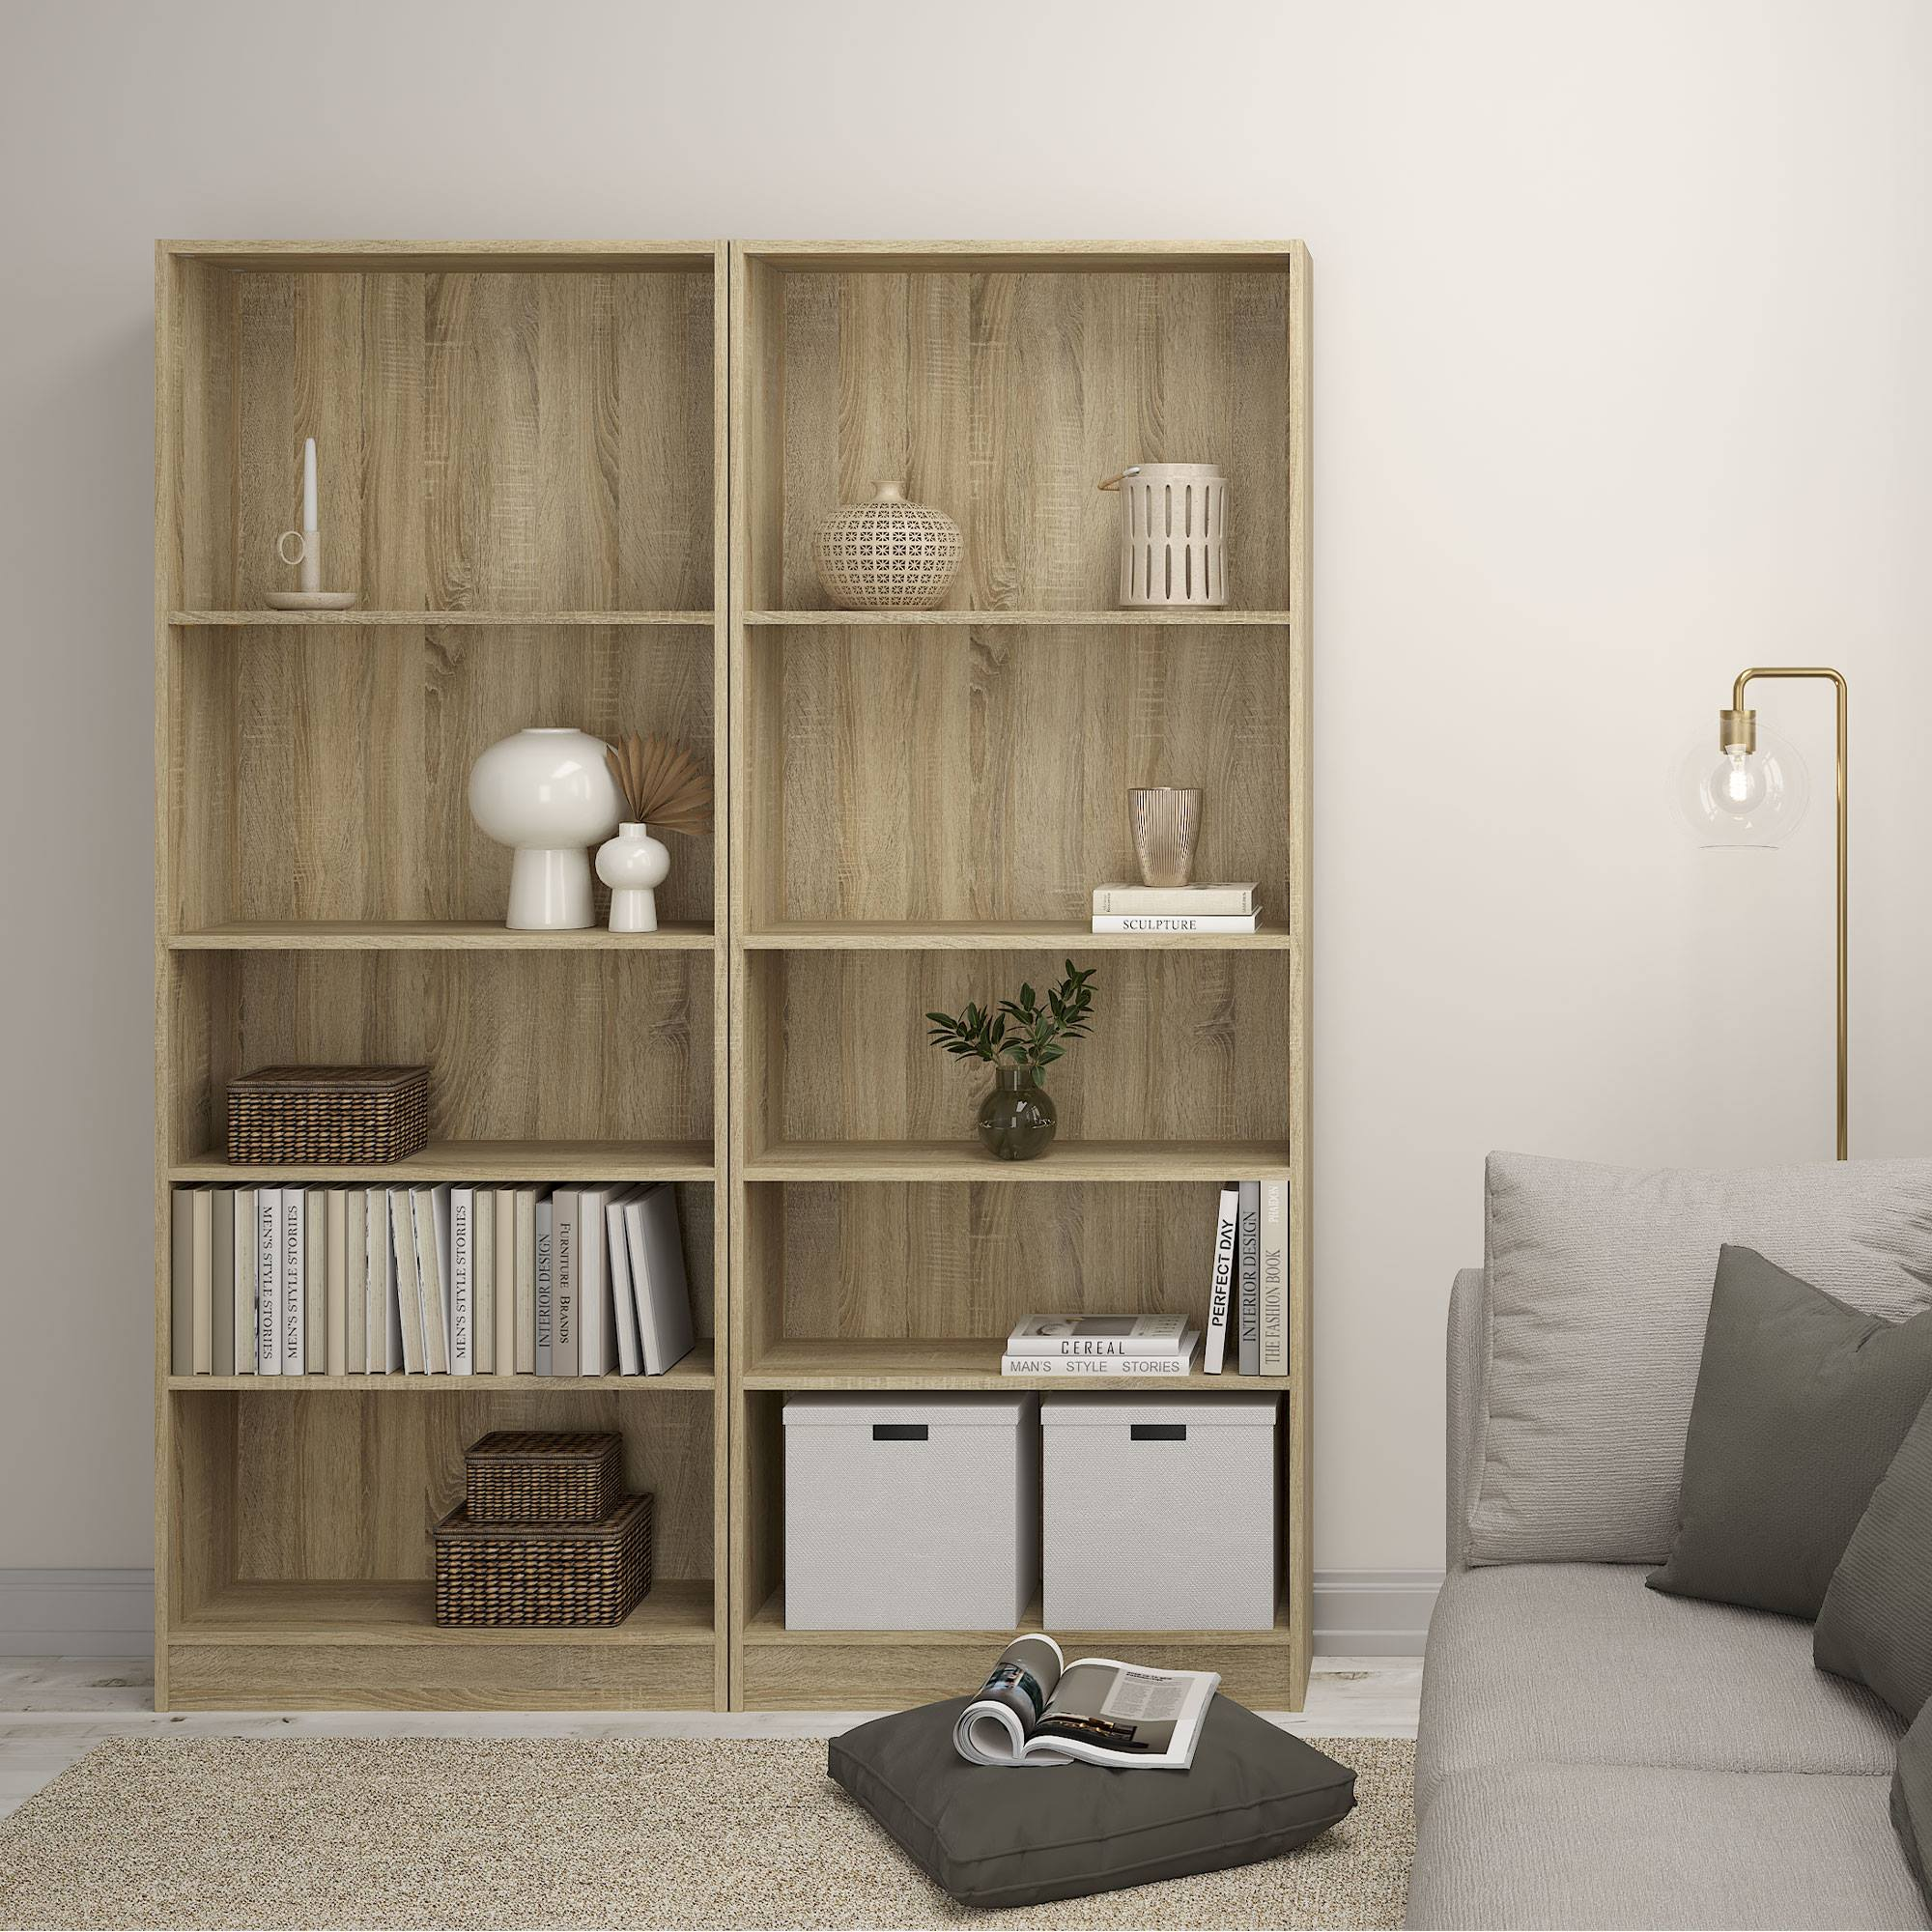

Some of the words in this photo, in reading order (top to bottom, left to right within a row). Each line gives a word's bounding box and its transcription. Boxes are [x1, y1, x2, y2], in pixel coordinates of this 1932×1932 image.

[1122, 920, 1197, 930] SCULPTURE
[263, 1206, 272, 1249] MEN'S
[288, 1206, 298, 1264] STORIES
[456, 1206, 466, 1264] STORIES
[1219, 1219, 1234, 1250] DAY
[1243, 1211, 1256, 1266] DESIGN
[263, 1253, 272, 1296] STYLE
[539, 1234, 551, 1282] DESIGN
[560, 1223, 571, 1289] FURNITURE
[1265, 1249, 1280, 1284] BOOK
[288, 1268, 298, 1313] STYLE
[456, 1268, 466, 1313] STYLE
[1211, 1254, 1230, 1326] PERFECT
[1243, 1271, 1256, 1342] INTERIOR
[1265, 1287, 1280, 1338] FASHION
[263, 1300, 272, 1359] STORIES
[288, 1316, 298, 1358] MEN'S
[456, 1316, 466, 1359] MEN'S
[539, 1286, 551, 1347] INTERIOR
[560, 1296, 571, 1344] BRANDS
[1010, 1361, 1052, 1373] MAN'S
[1066, 1361, 1108, 1373] STYLE
[1122, 1361, 1180, 1373] STORIES
[1062, 1341, 1125, 1354] CEREAL
[1265, 1341, 1280, 1364] THE
